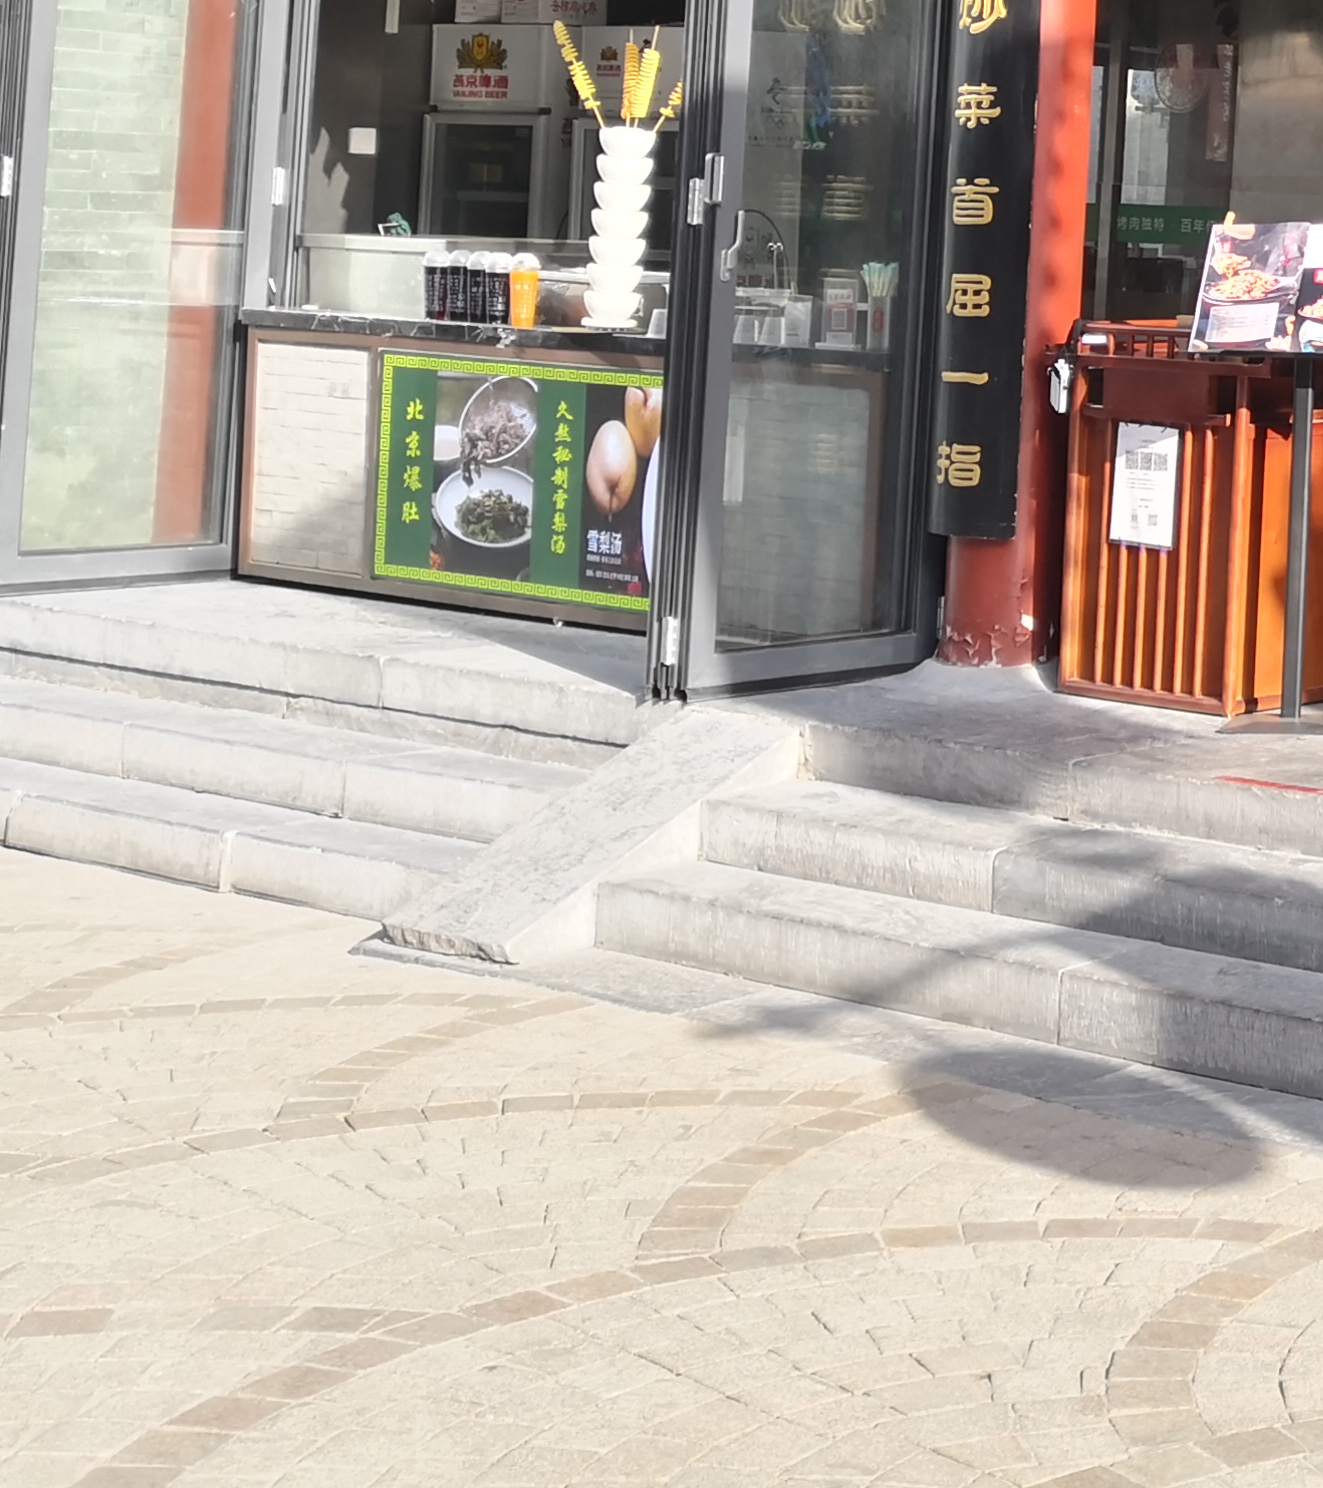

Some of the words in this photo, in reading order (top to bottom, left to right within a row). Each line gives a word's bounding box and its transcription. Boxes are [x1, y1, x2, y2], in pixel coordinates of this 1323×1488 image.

[485, 90, 509, 99] BEER
[401, 398, 425, 525] 北京爆肚
[550, 400, 574, 555] 久熬秘制雪梨汤
